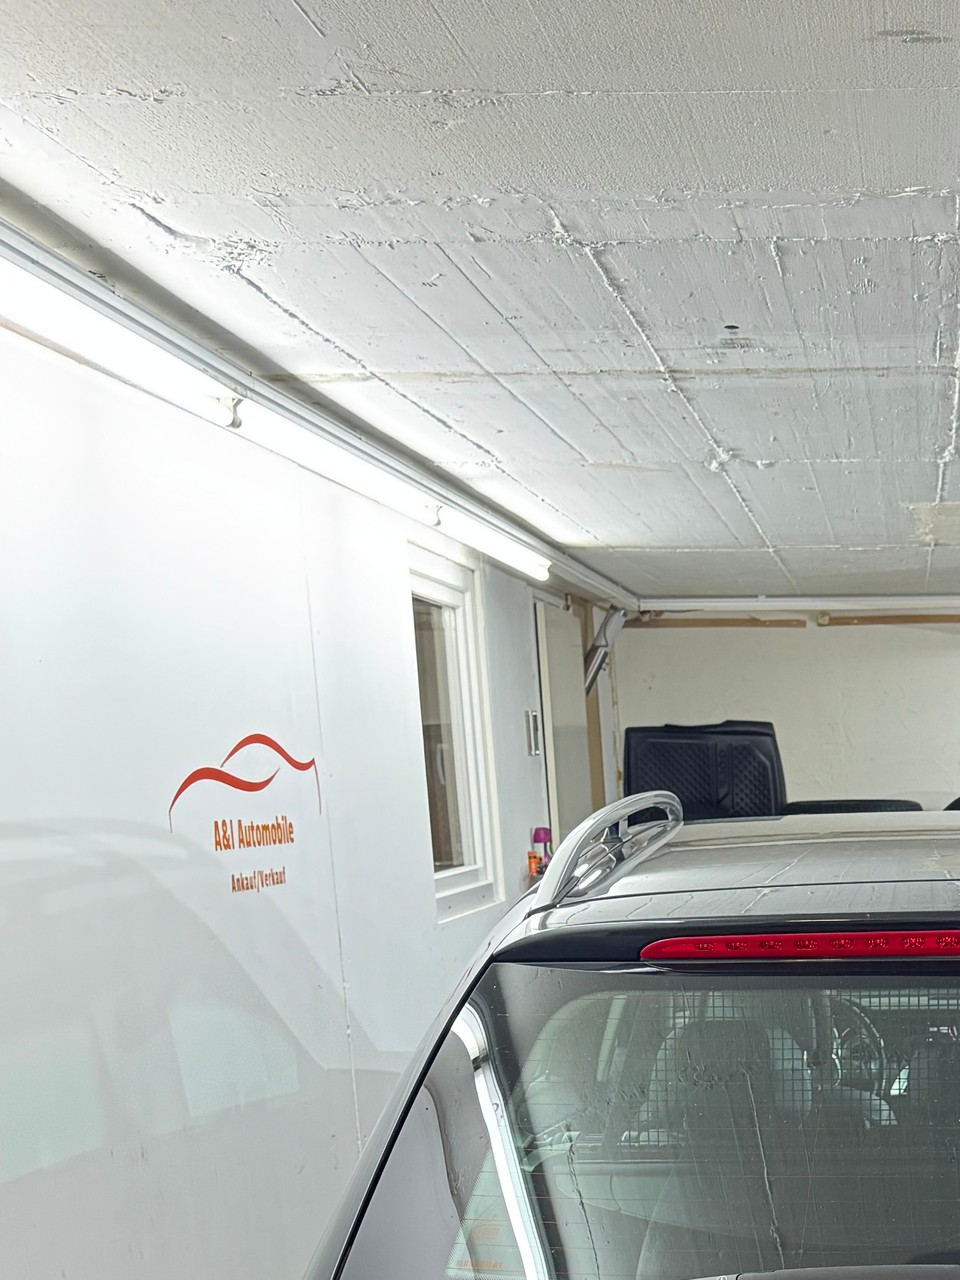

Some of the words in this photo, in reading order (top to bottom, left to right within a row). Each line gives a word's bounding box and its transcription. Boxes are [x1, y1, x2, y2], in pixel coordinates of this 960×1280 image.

[213, 819, 236, 851] A&I
[237, 815, 295, 848] Automobile
[231, 866, 287, 893] Ankauf/Verkauf
